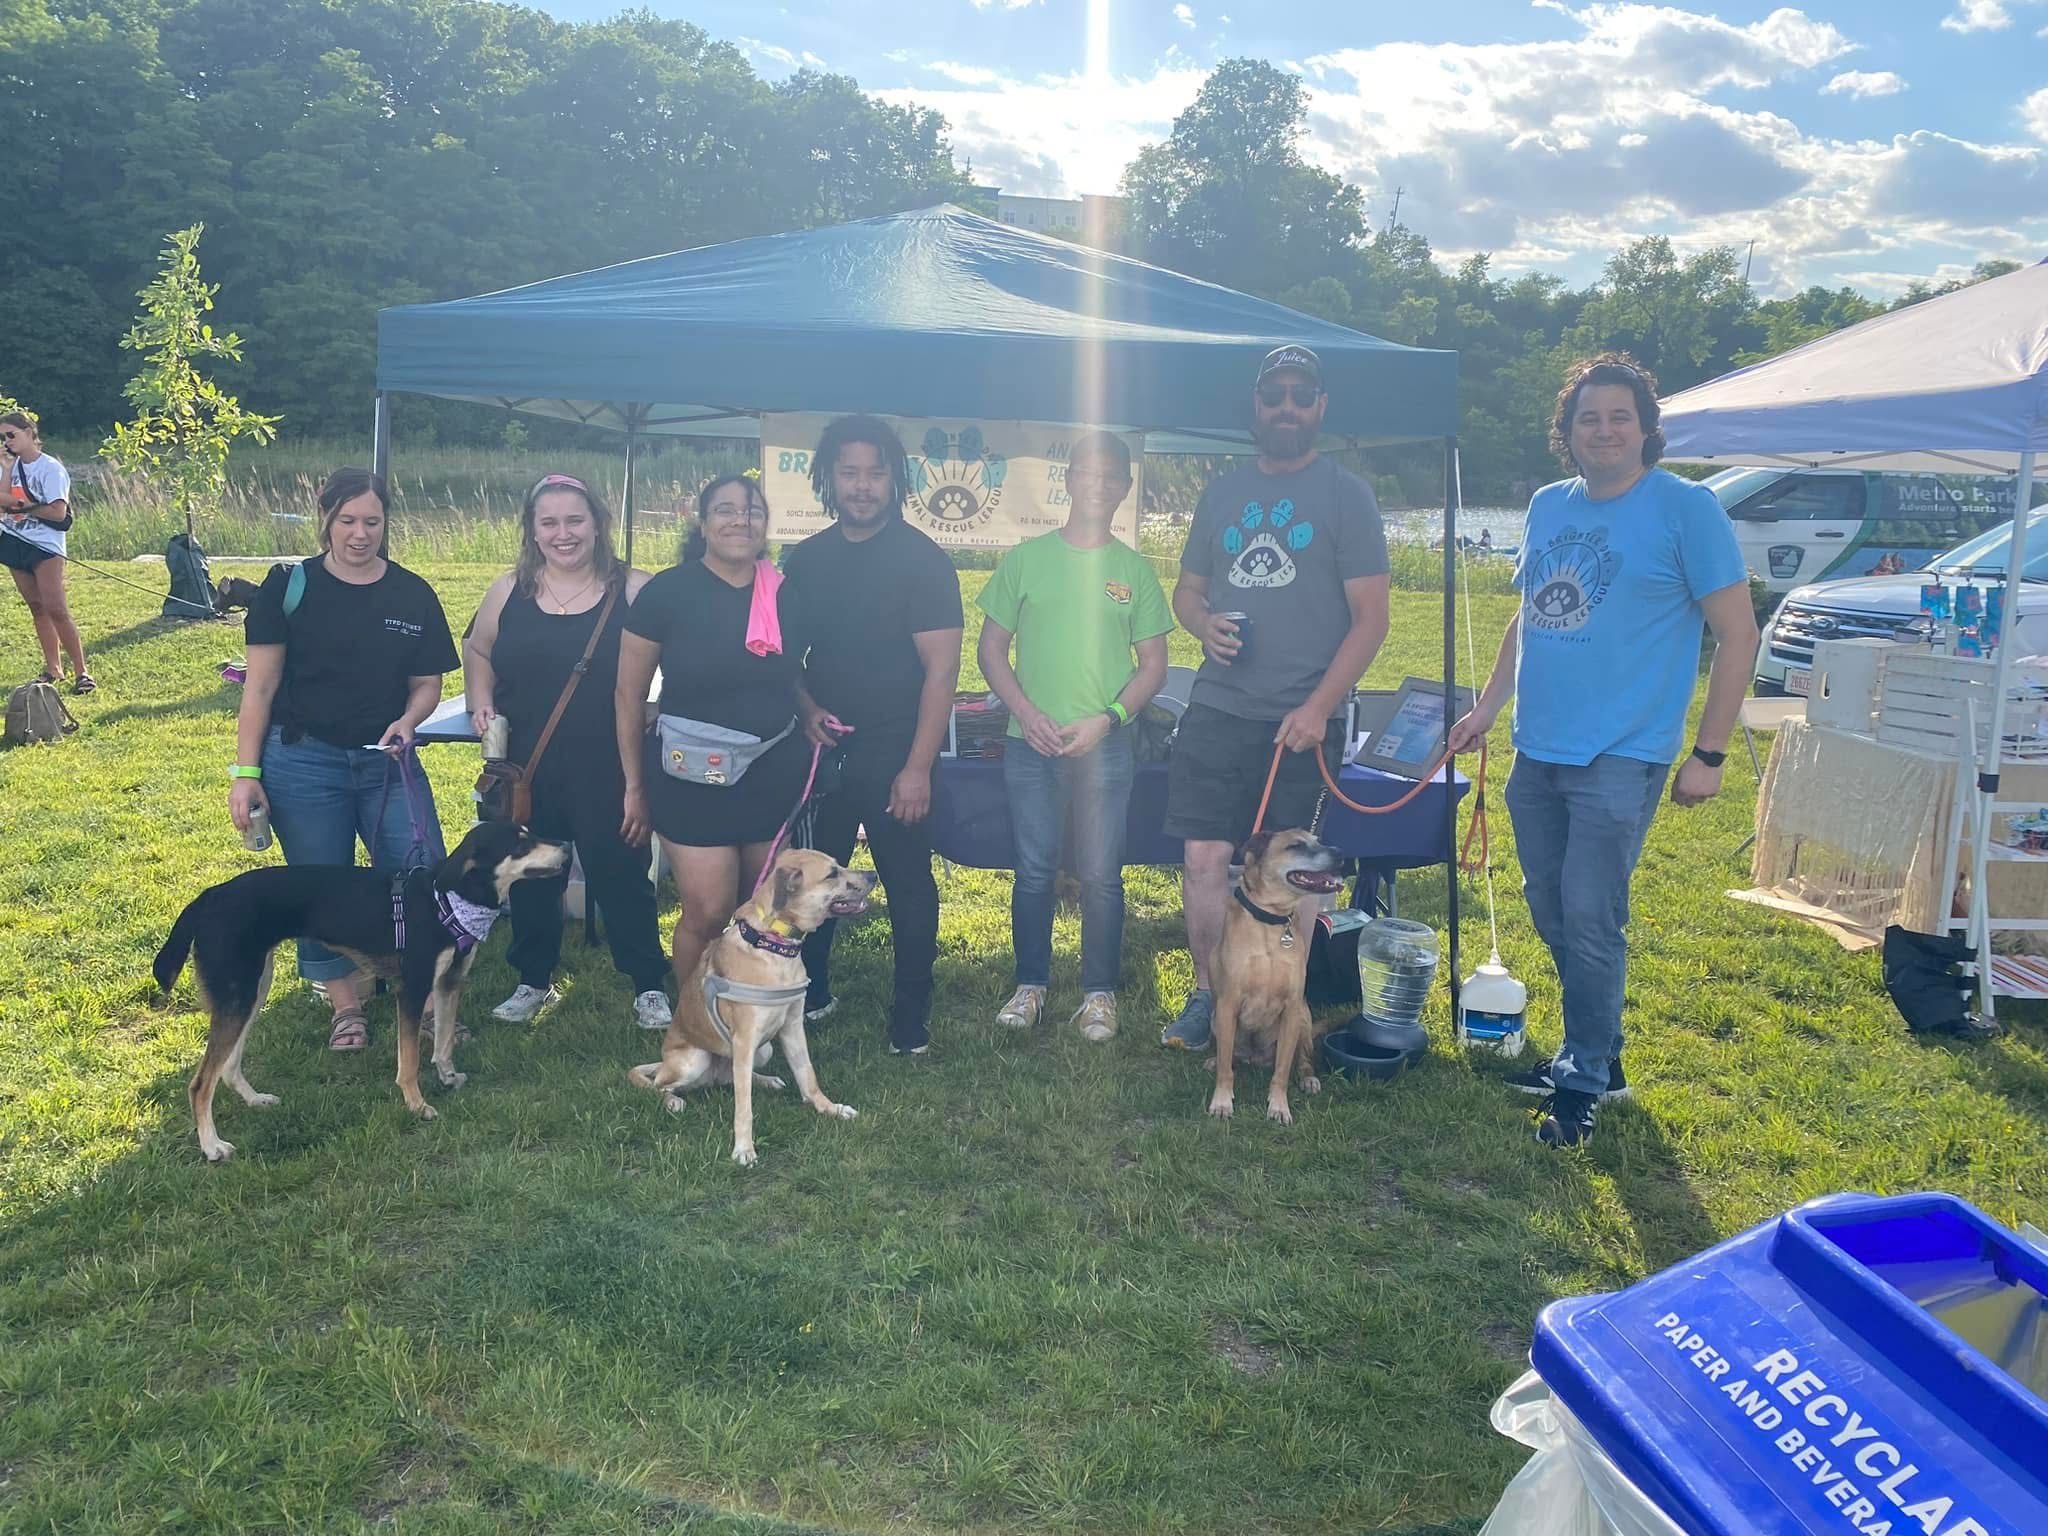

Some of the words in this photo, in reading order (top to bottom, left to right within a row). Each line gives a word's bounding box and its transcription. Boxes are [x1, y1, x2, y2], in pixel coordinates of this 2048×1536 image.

[1899, 486, 1965, 501] Metro
[1973, 487, 2017, 503] Park
[1899, 503, 1958, 513] Adventure
[1961, 504, 1997, 513] starts
[929, 521, 975, 533] RESCUE
[1530, 612, 1570, 630] RESCUE
[1575, 579, 1611, 622] LEAGUE
[1654, 1311, 1731, 1383] PAPER
[1720, 1379, 1783, 1431] AND
